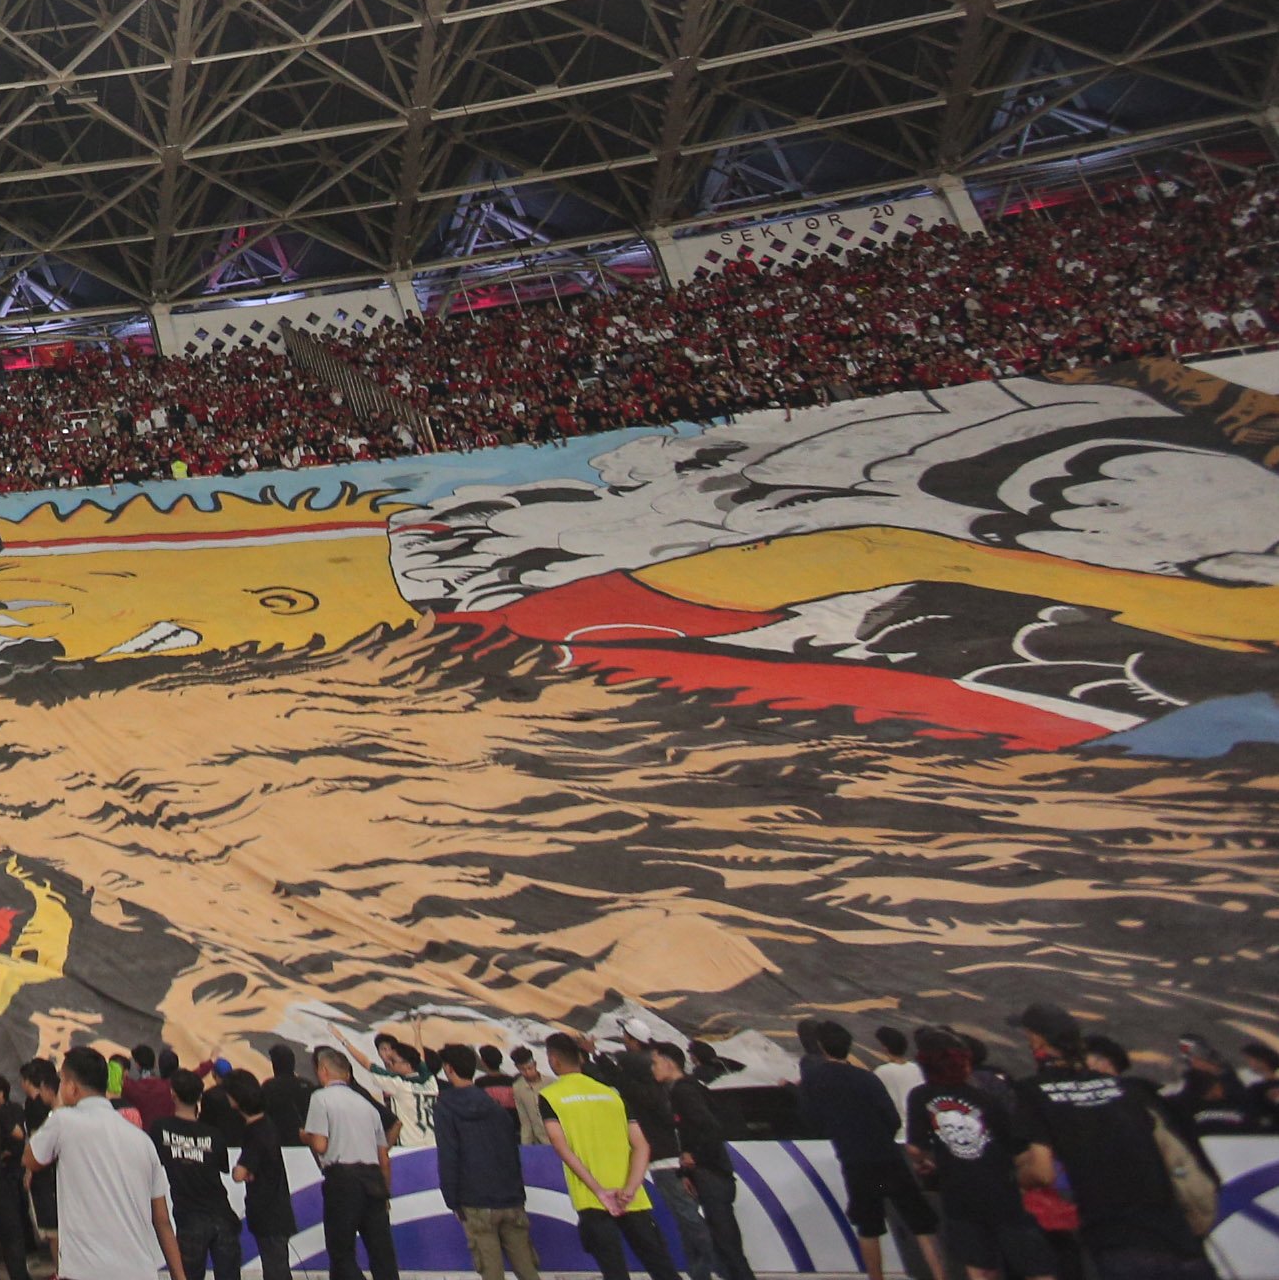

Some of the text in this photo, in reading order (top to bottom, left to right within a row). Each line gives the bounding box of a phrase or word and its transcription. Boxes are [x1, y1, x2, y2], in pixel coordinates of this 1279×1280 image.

[720, 203, 896, 245] SEKTOR 20
[162, 1129, 171, 1144] IN
[196, 1136, 212, 1150] SUD
[171, 1145, 183, 1159] WE
